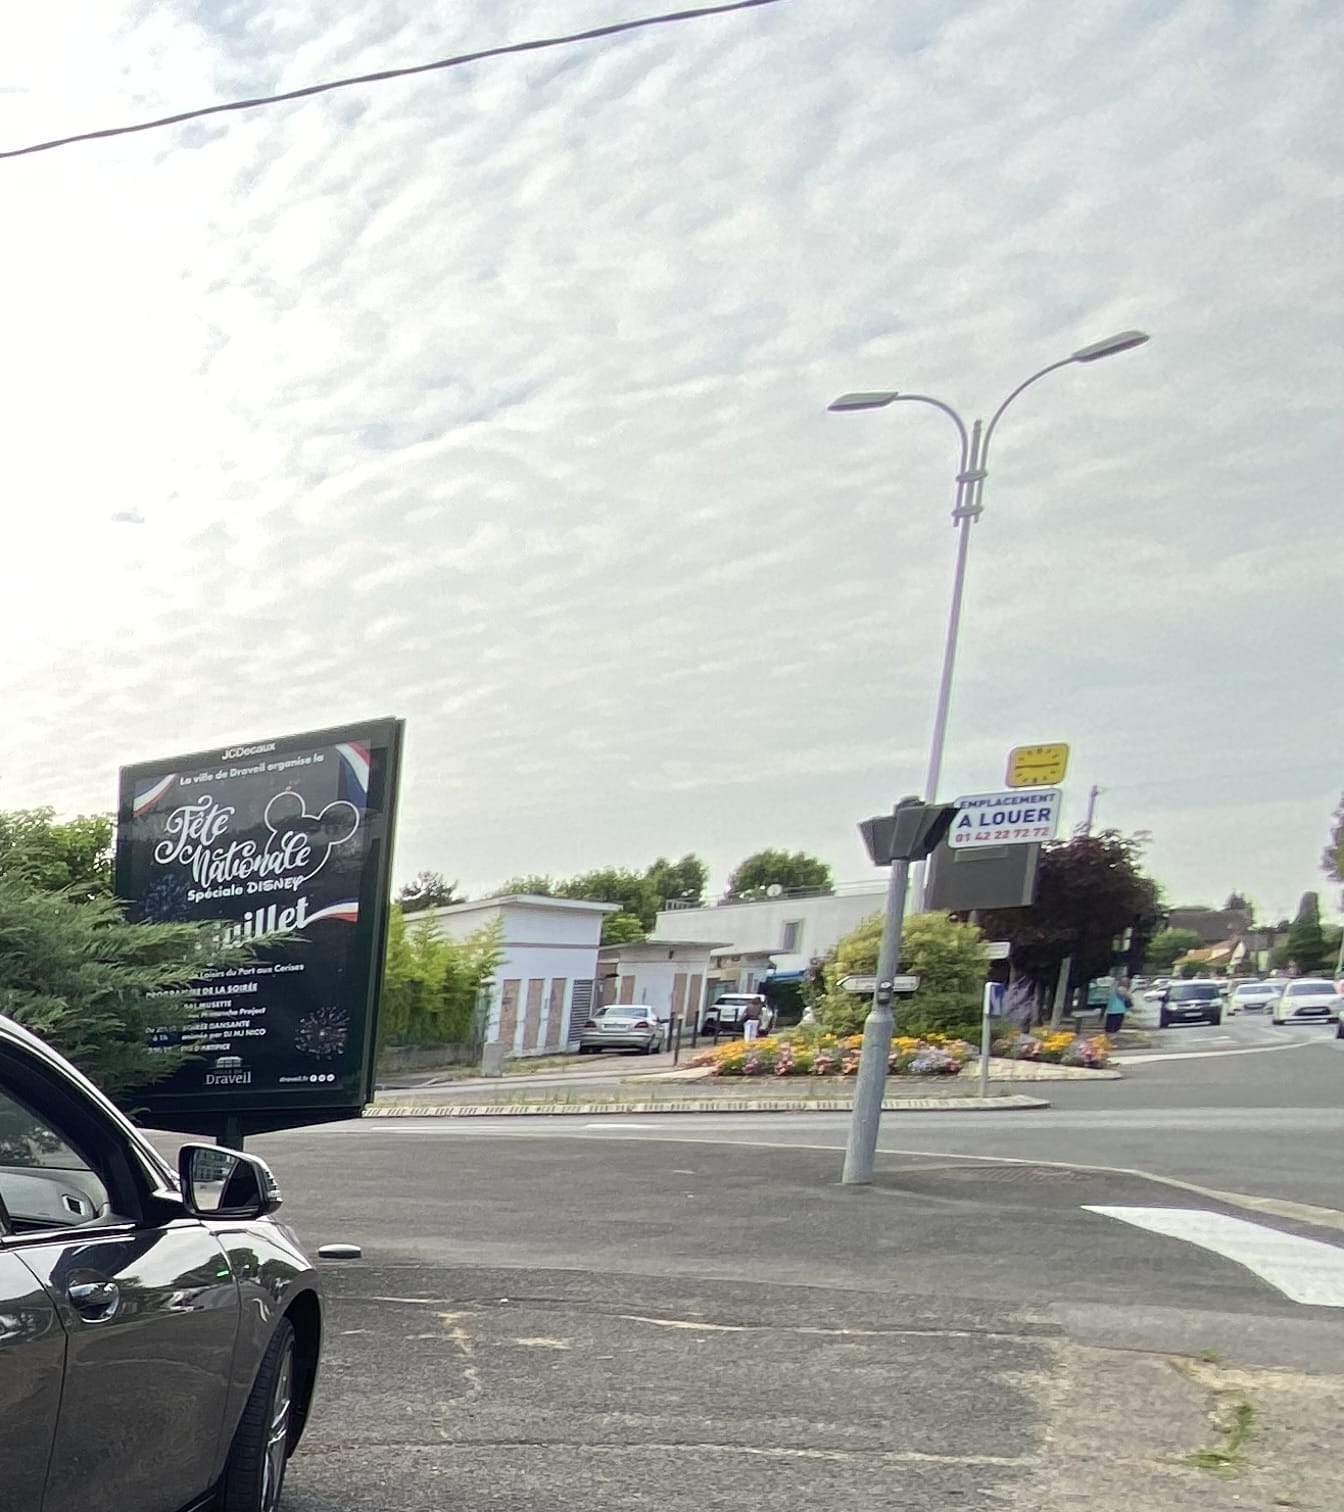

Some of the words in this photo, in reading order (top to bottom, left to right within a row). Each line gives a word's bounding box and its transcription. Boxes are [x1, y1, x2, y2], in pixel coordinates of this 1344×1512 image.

[221, 743, 276, 760] JCDecaux
[180, 774, 192, 786] La
[193, 771, 213, 784] ville
[215, 769, 228, 780] de
[229, 762, 265, 778] Draveil
[267, 756, 312, 773] organise
[313, 753, 324, 763] la
[960, 793, 1056, 809] EMPLACEMENT
[957, 814, 972, 828] A
[979, 808, 1051, 827] LOUER
[155, 795, 235, 864] Fête
[956, 833, 970, 843] 01
[975, 831, 991, 841] 42
[994, 830, 1010, 840] 22
[1014, 828, 1030, 838] 72
[1033, 827, 1049, 837] 72
[179, 831, 312, 889] Nationale
[187, 884, 243, 903] Spéciale
[246, 876, 305, 893] DISNEY
[206, 1072, 251, 1085] Draveil
